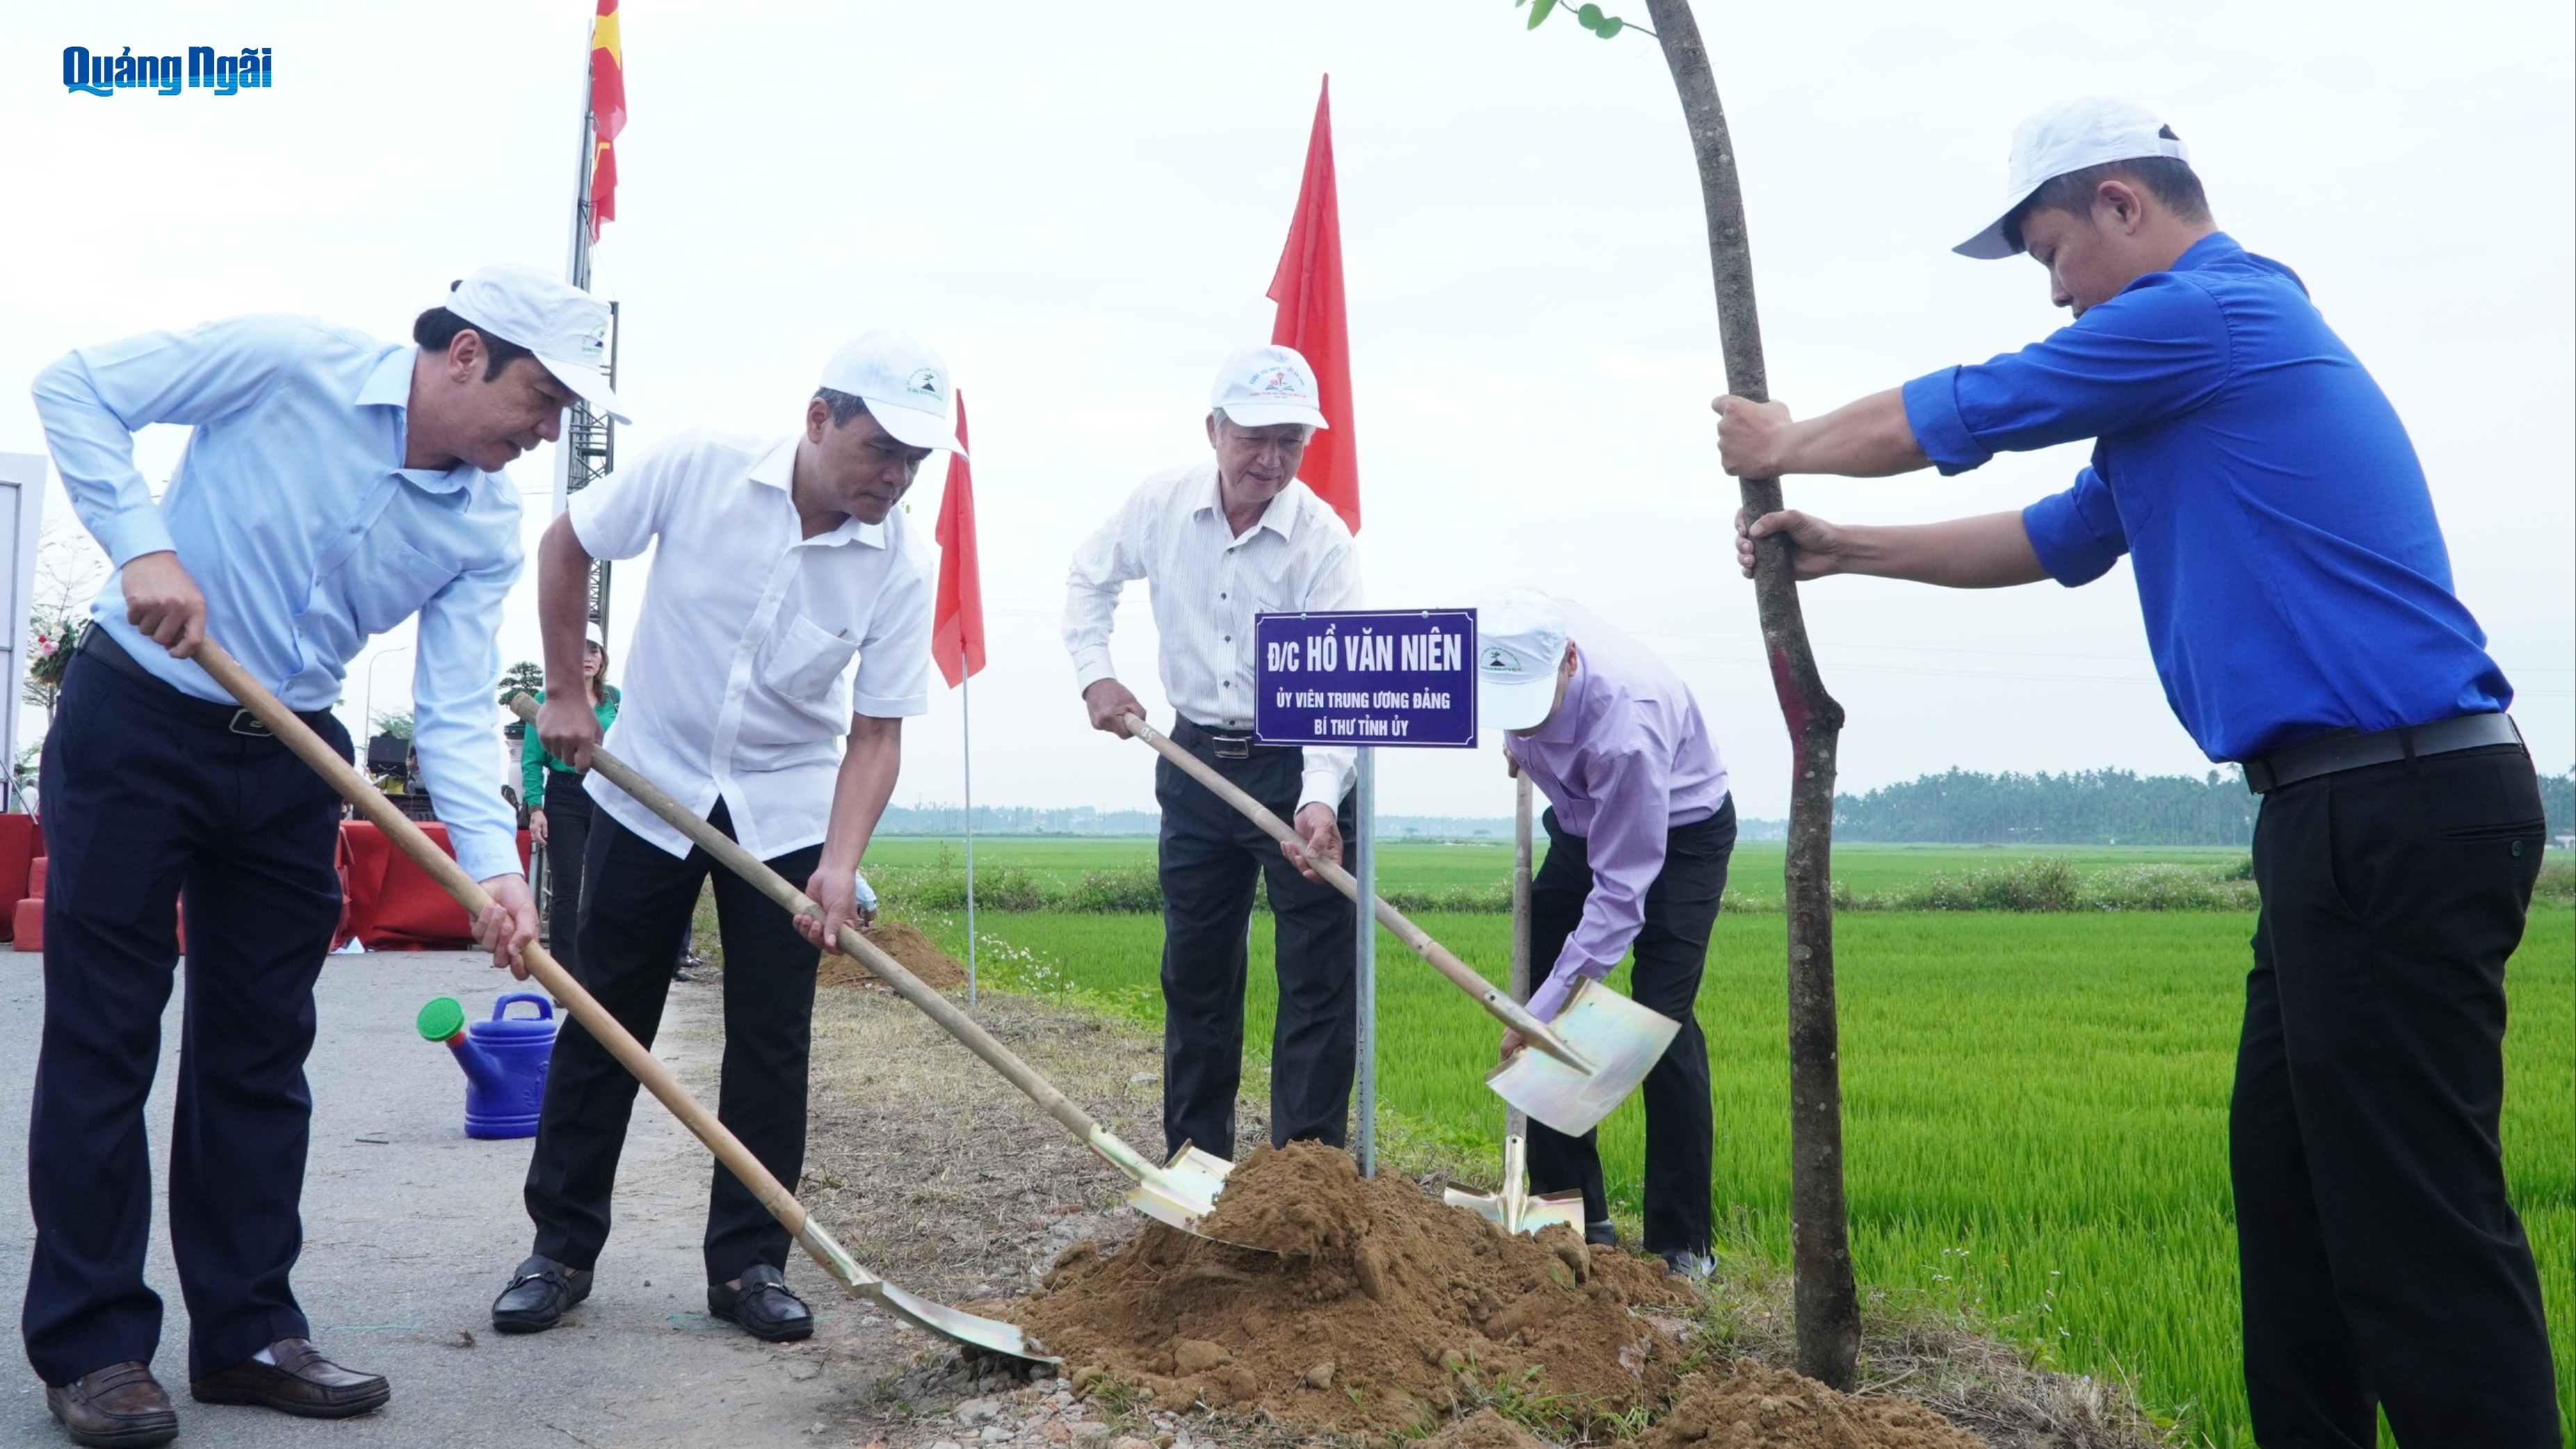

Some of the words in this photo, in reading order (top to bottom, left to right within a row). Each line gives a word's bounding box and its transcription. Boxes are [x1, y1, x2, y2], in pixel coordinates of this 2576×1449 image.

[1267, 642, 1299, 672] Đ/C
[1307, 624, 1337, 672] HỒ
[1345, 627, 1393, 672] VĂN
[1401, 626, 1461, 671] NIÊN
[1277, 686, 1293, 708] ỦY
[1295, 688, 1324, 708] VIÊN
[1327, 692, 1370, 709] TRUNG
[1372, 690, 1409, 709] ƯƠNG
[1412, 687, 1450, 709] ĐẢNG
[1314, 715, 1327, 736] BÍ
[1330, 718, 1356, 736] THƯ
[1358, 714, 1388, 736] TỈNH
[1391, 714, 1409, 736] ỦY
